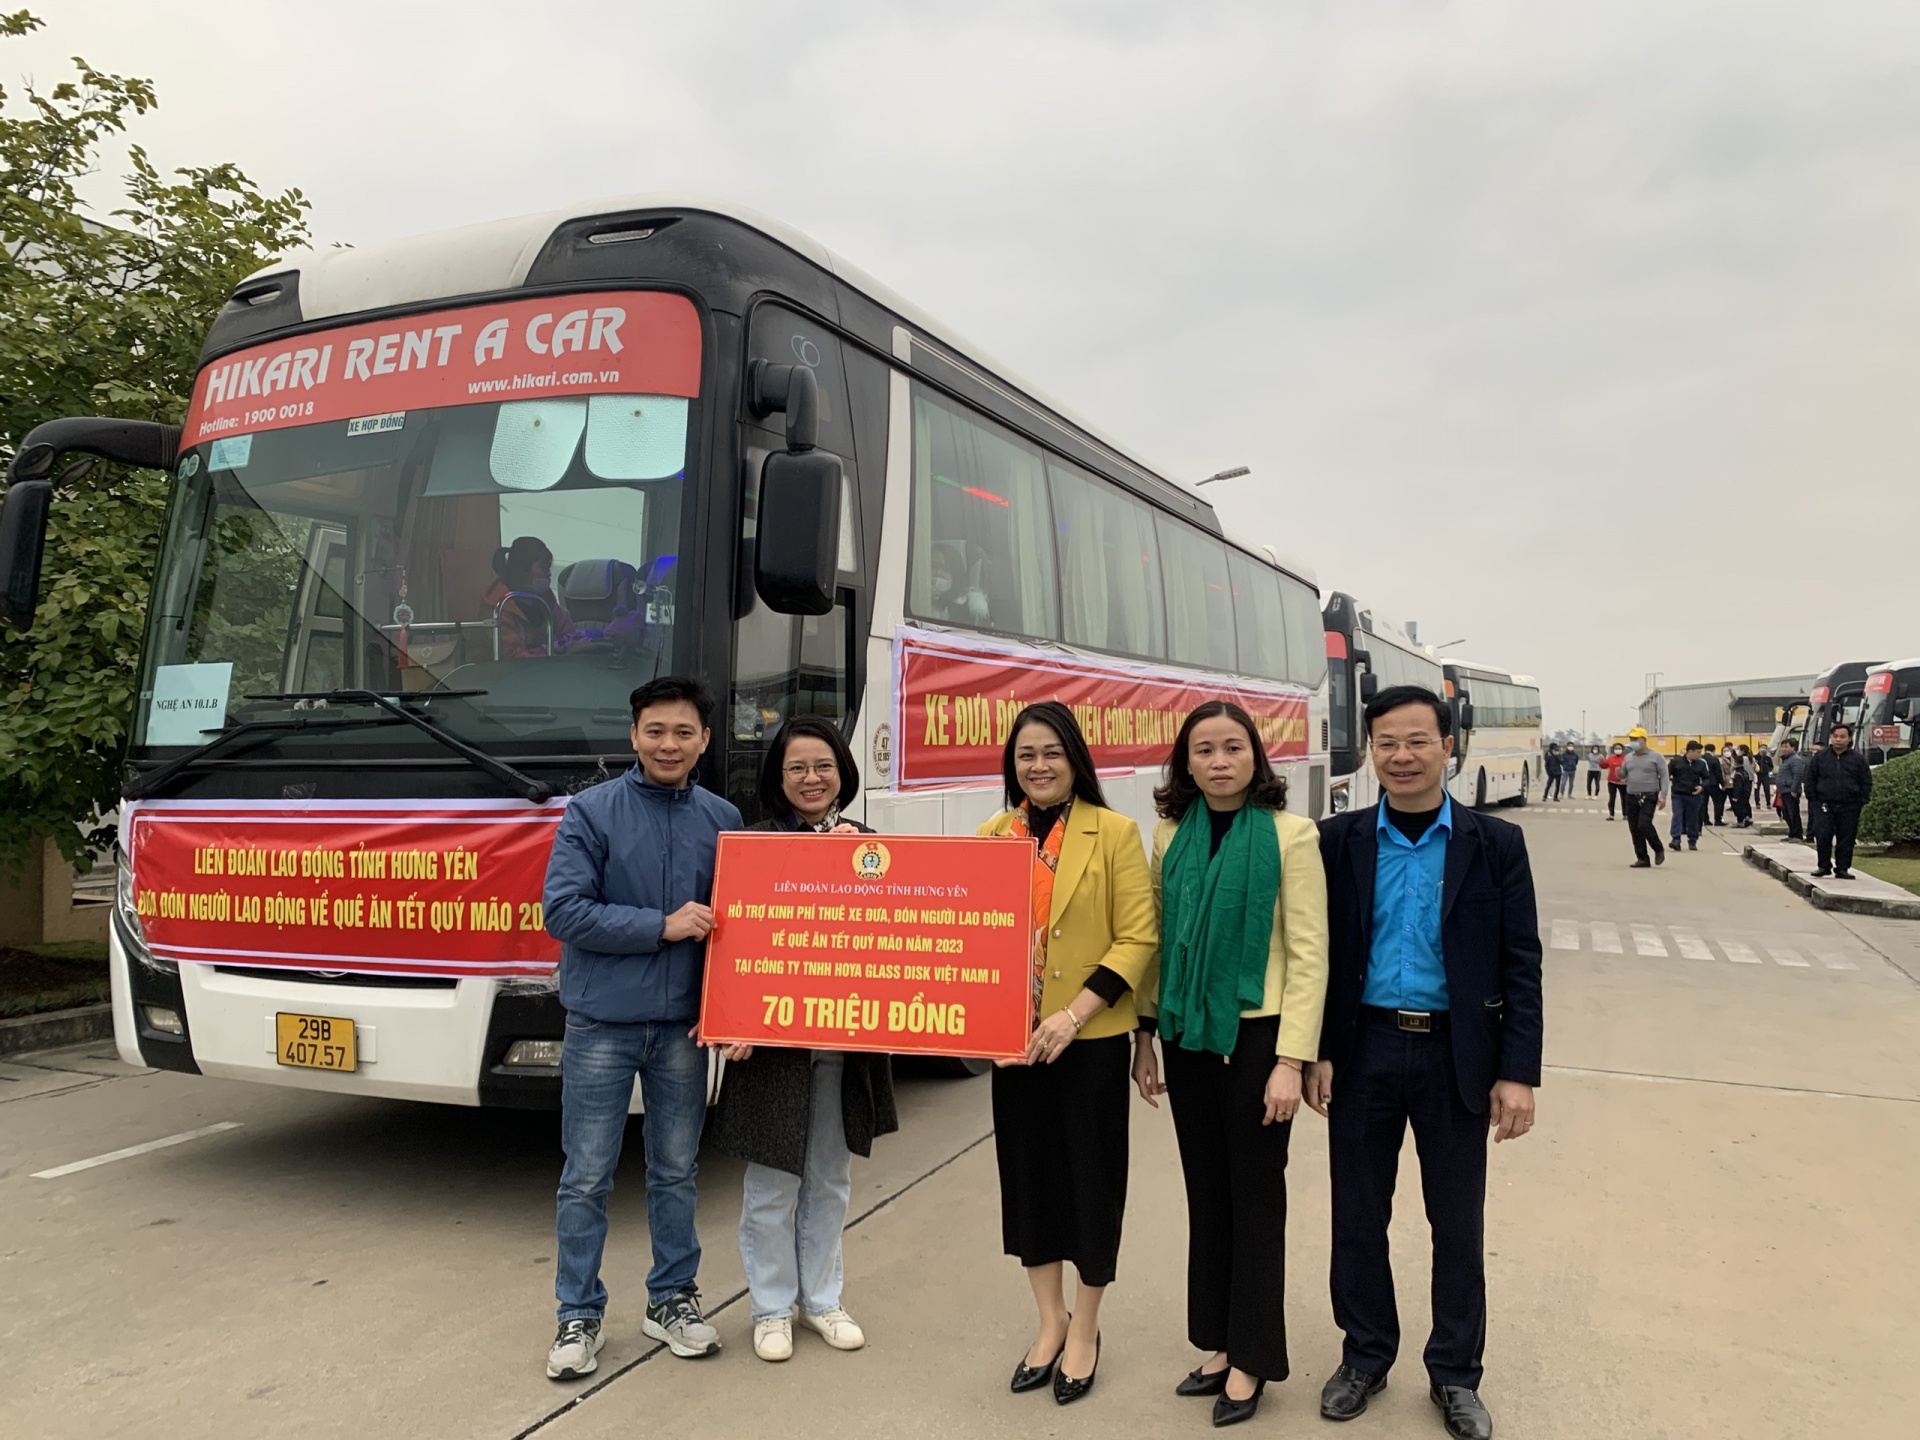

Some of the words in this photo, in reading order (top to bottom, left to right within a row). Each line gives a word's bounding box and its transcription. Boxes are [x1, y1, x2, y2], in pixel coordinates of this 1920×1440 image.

[204, 344, 333, 411] HIKARI
[343, 324, 462, 382] RENT
[474, 318, 510, 367] A
[525, 307, 626, 359] CAR
[468, 370, 620, 394] www.hikari.com.vn
[199, 417, 239, 437] Hotline:
[244, 407, 277, 425] 1900
[279, 401, 314, 418] 0018
[349, 421, 360, 432] XE
[361, 418, 379, 432] HỢP
[156, 698, 179, 712] NGHỆ
[180, 698, 192, 709] AN
[194, 698, 218, 709] 10.1.B
[923, 693, 949, 746] XE
[955, 692, 991, 746] ĐƯA
[1104, 699, 1133, 746] CÔNG
[1135, 702, 1161, 745] ĐOÀN
[270, 849, 298, 877] LAO
[301, 845, 344, 884] ĐỘNG
[349, 841, 386, 879] TỈNH
[391, 848, 438, 880] HƯNG
[443, 845, 478, 880] YÊN
[774, 880, 798, 893] LIÊN
[800, 881, 829, 893] ĐOÀN
[830, 884, 852, 894] LAO
[854, 884, 884, 897] ĐỘNG
[886, 883, 911, 896] TỈNH
[914, 885, 945, 897] HƯNG
[947, 884, 968, 897] YÊN
[160, 887, 186, 919] ĐÓN
[189, 888, 231, 922] NGƯỜI
[235, 896, 261, 924] LAO
[264, 891, 306, 930] ĐỘNG
[310, 889, 329, 926] VỀ
[333, 893, 365, 930] QUÊ
[368, 893, 392, 928] ĂN
[396, 891, 426, 929] TẾT
[430, 895, 465, 934] QUÝ
[470, 896, 513, 932] MÃO
[728, 899, 743, 918] HỖ
[745, 904, 766, 922] TRỢ
[768, 905, 795, 919] KINH
[796, 903, 816, 920] PHÍ
[818, 904, 846, 921] THUÊ
[848, 908, 863, 922] XE
[865, 907, 891, 924] ĐƯA,
[894, 906, 918, 923] ĐÓN
[920, 907, 956, 925] NGƯỜI
[958, 911, 980, 926] LAO
[983, 909, 1015, 930] ĐỘNG
[787, 930, 809, 948] QUÊ
[811, 931, 828, 949] ĂN
[831, 930, 850, 949] TẾT
[852, 933, 875, 951] QUÝ
[877, 934, 903, 951] MÃO
[905, 935, 933, 952] NĂM
[935, 938, 964, 954] 2023
[735, 958, 752, 976] TẠI
[754, 956, 785, 975] CÔNG
[787, 961, 800, 975] TY
[803, 961, 832, 977] TNHH
[834, 962, 862, 978] HOYA
[865, 963, 901, 979] GLASS
[903, 965, 931, 981] DISK
[934, 964, 958, 985] VIỆT
[960, 968, 989, 983] NAM
[991, 969, 1000, 984] II
[762, 996, 795, 1027] 70
[803, 992, 880, 1036] TRIỆU
[888, 992, 966, 1035] ĐỒNG
[298, 1018, 331, 1041] 29B
[286, 1041, 346, 1068] 407.57
